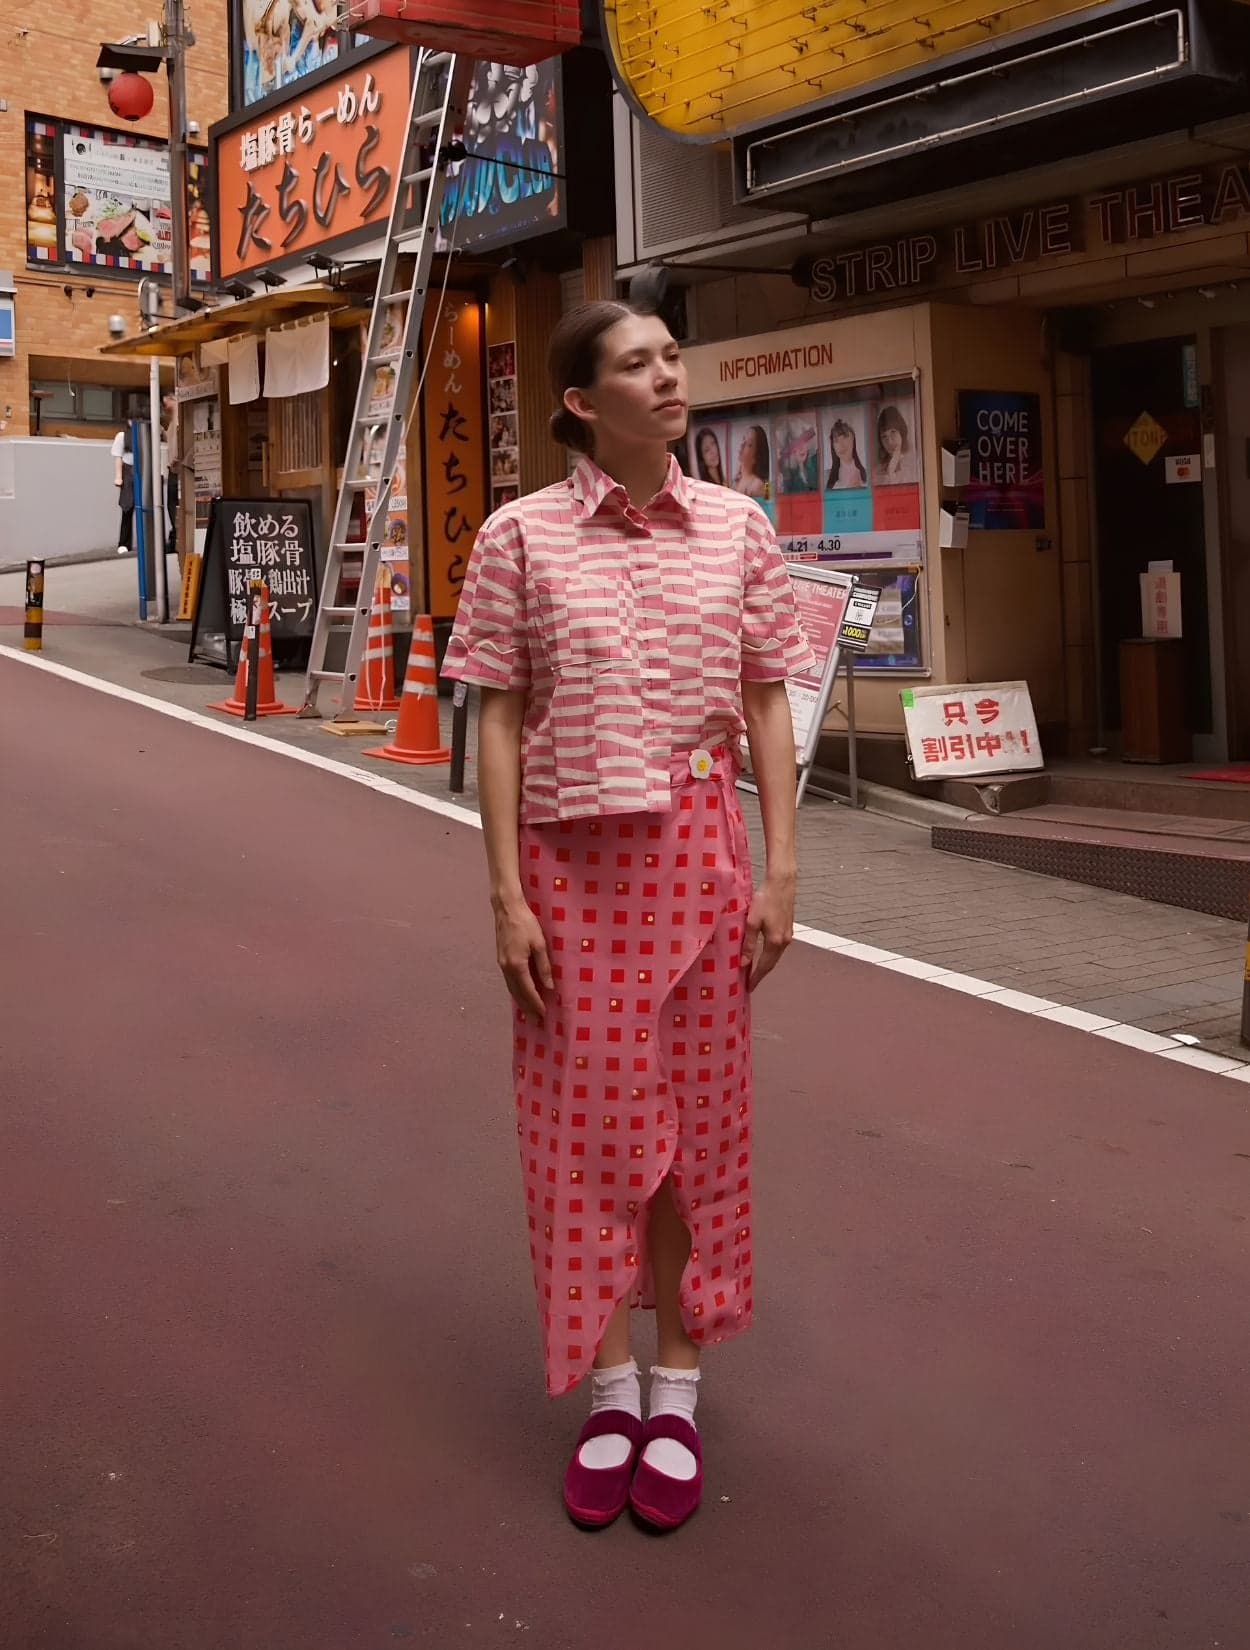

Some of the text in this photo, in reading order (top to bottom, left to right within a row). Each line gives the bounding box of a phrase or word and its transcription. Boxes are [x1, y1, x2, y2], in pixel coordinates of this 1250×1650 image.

[240, 73, 380, 172] 塩豚骨らーめん
[236, 124, 391, 260] たちひら
[811, 165, 1250, 302] STRIP LIVE THEA
[443, 302, 462, 394] らーめん
[719, 342, 833, 382] INFORMATION
[976, 409, 1029, 433] COME
[977, 435, 1029, 459] OVER
[978, 461, 1029, 486] HERE
[439, 402, 472, 598] たちひら
[232, 511, 299, 539] 飲める
[230, 540, 304, 567] 塩豚骨
[817, 538, 841, 552] 4.30
[230, 598, 313, 625] 極スープ
[943, 698, 1001, 727] 只今
